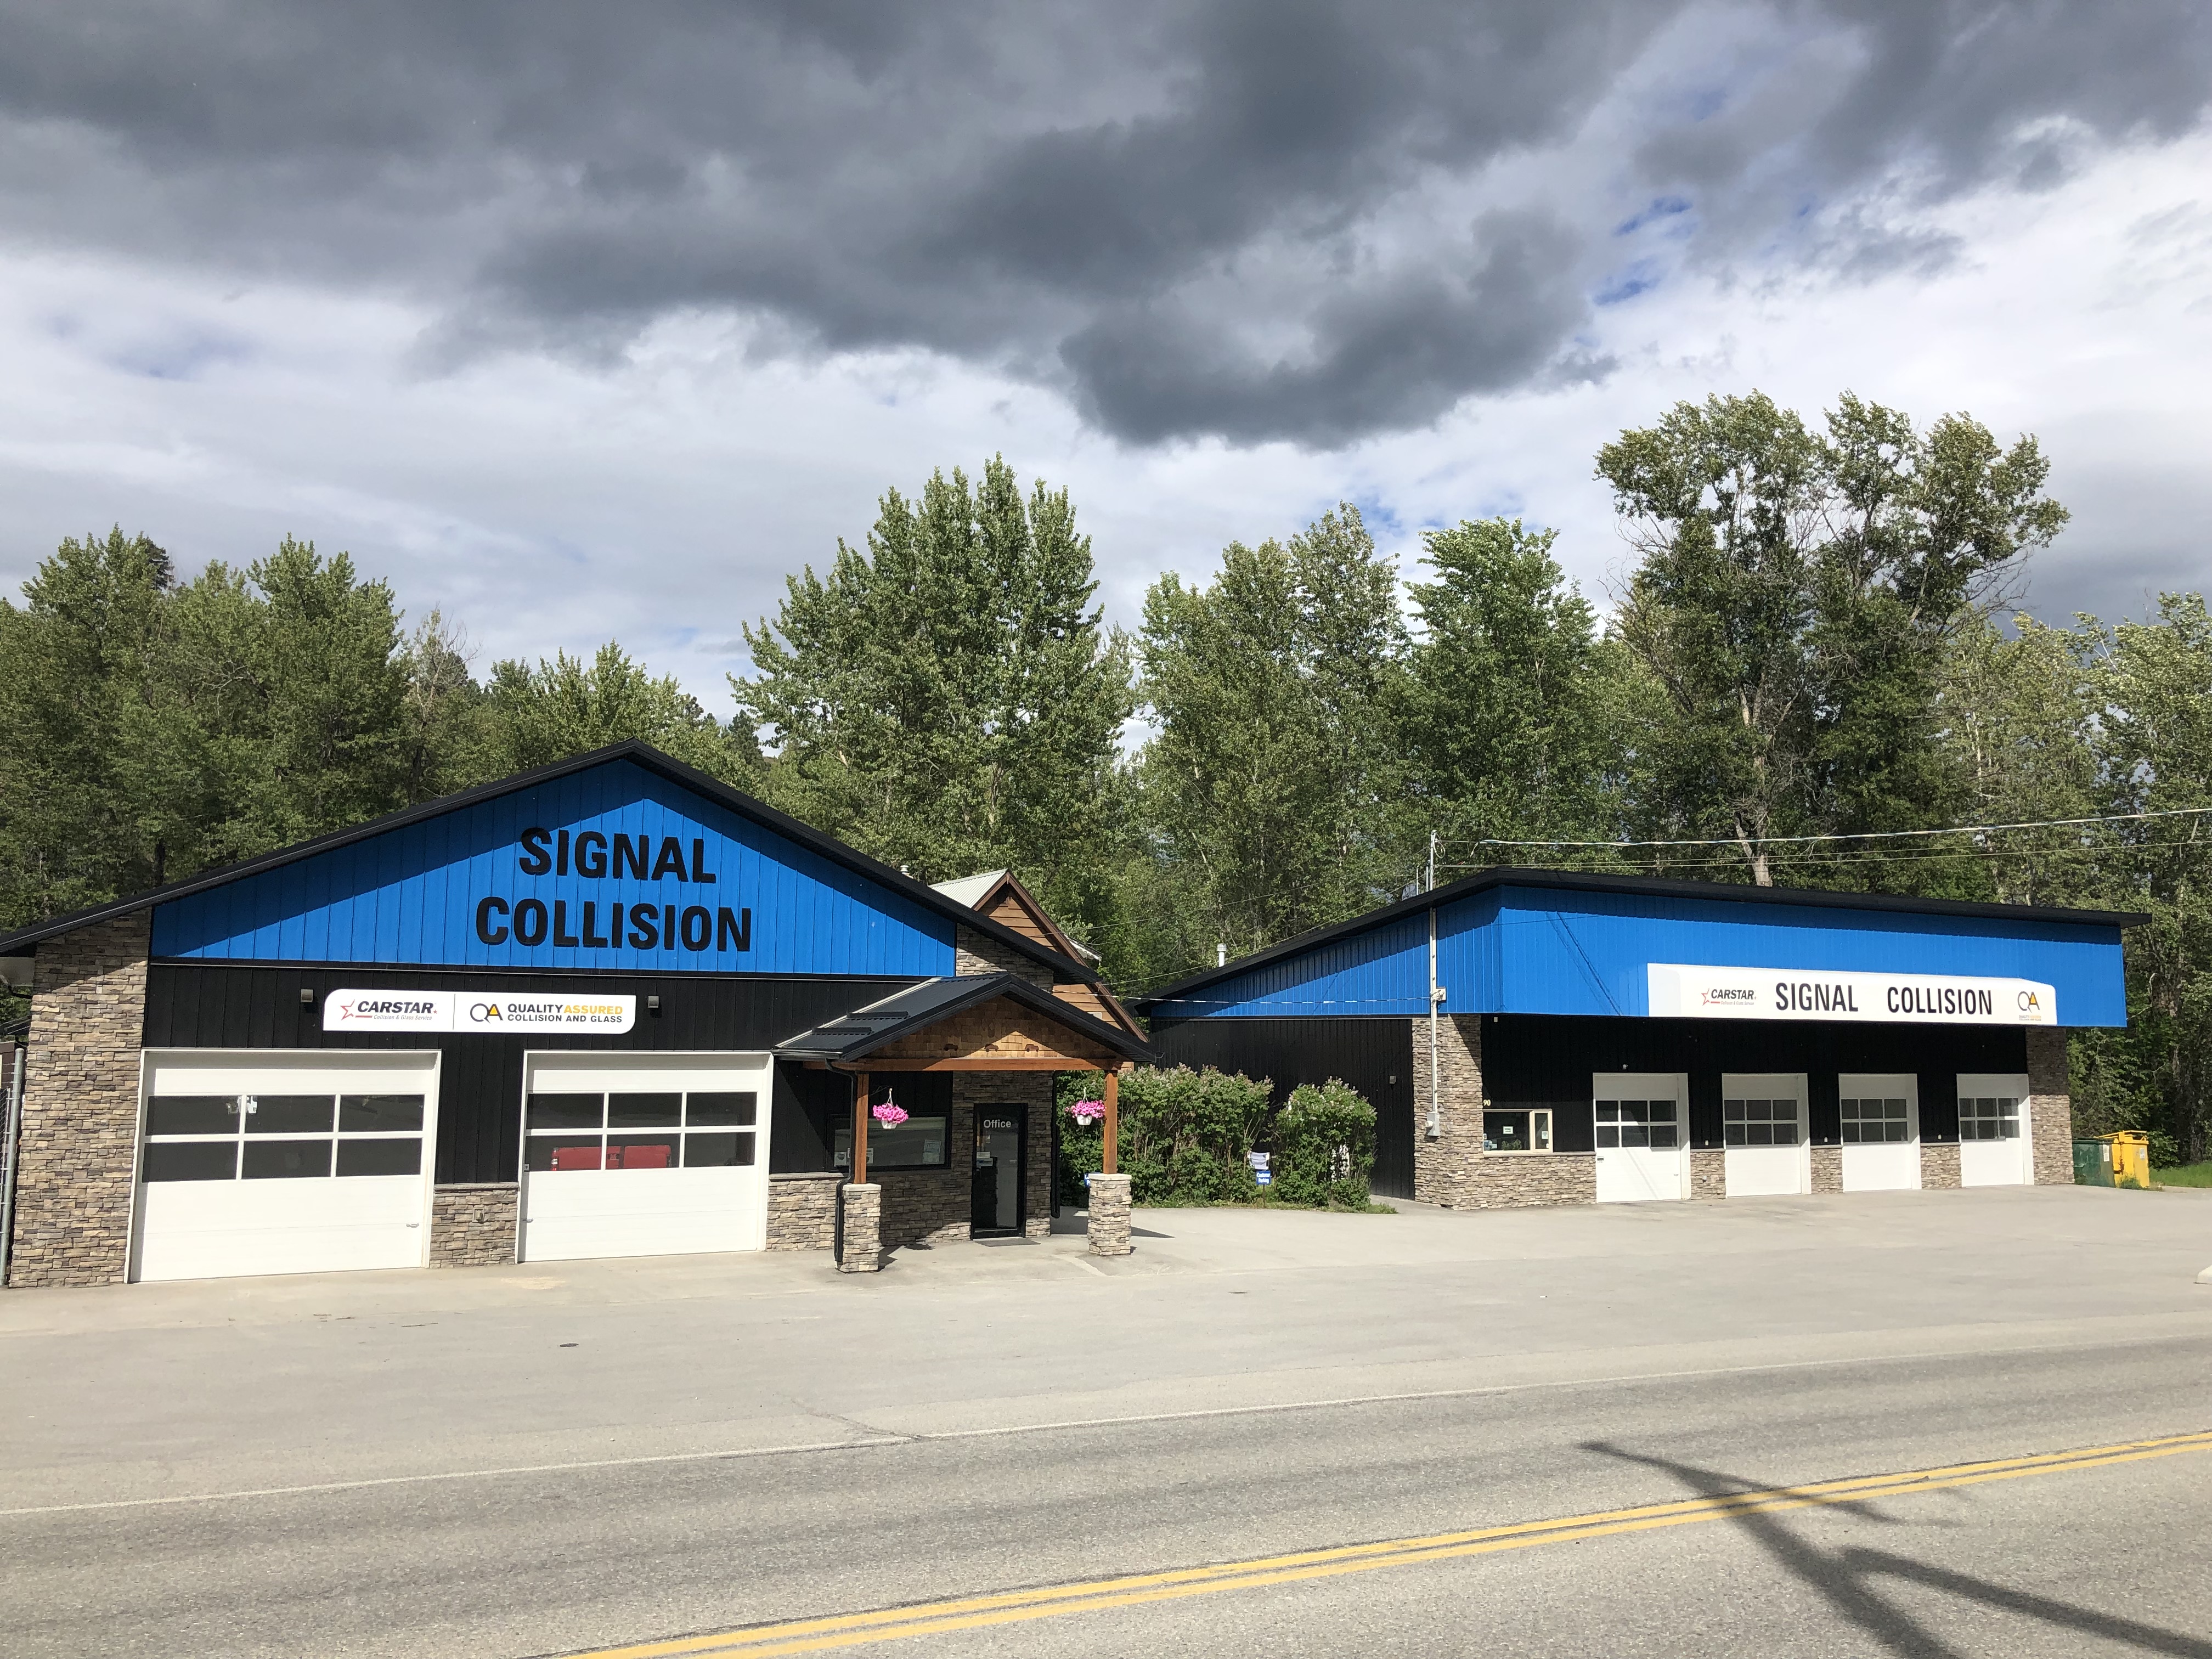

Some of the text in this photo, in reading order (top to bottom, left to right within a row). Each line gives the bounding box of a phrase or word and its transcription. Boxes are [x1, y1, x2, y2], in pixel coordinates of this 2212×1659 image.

[519, 827, 716, 884] SIGNAL
[476, 896, 752, 952] COLLISION
[1711, 989, 1754, 1000] CARSTAR
[1775, 982, 1992, 1015] SIGNAL COLLISION
[358, 1001, 434, 1014] CARSTAR
[983, 1119, 1012, 1128] Office
